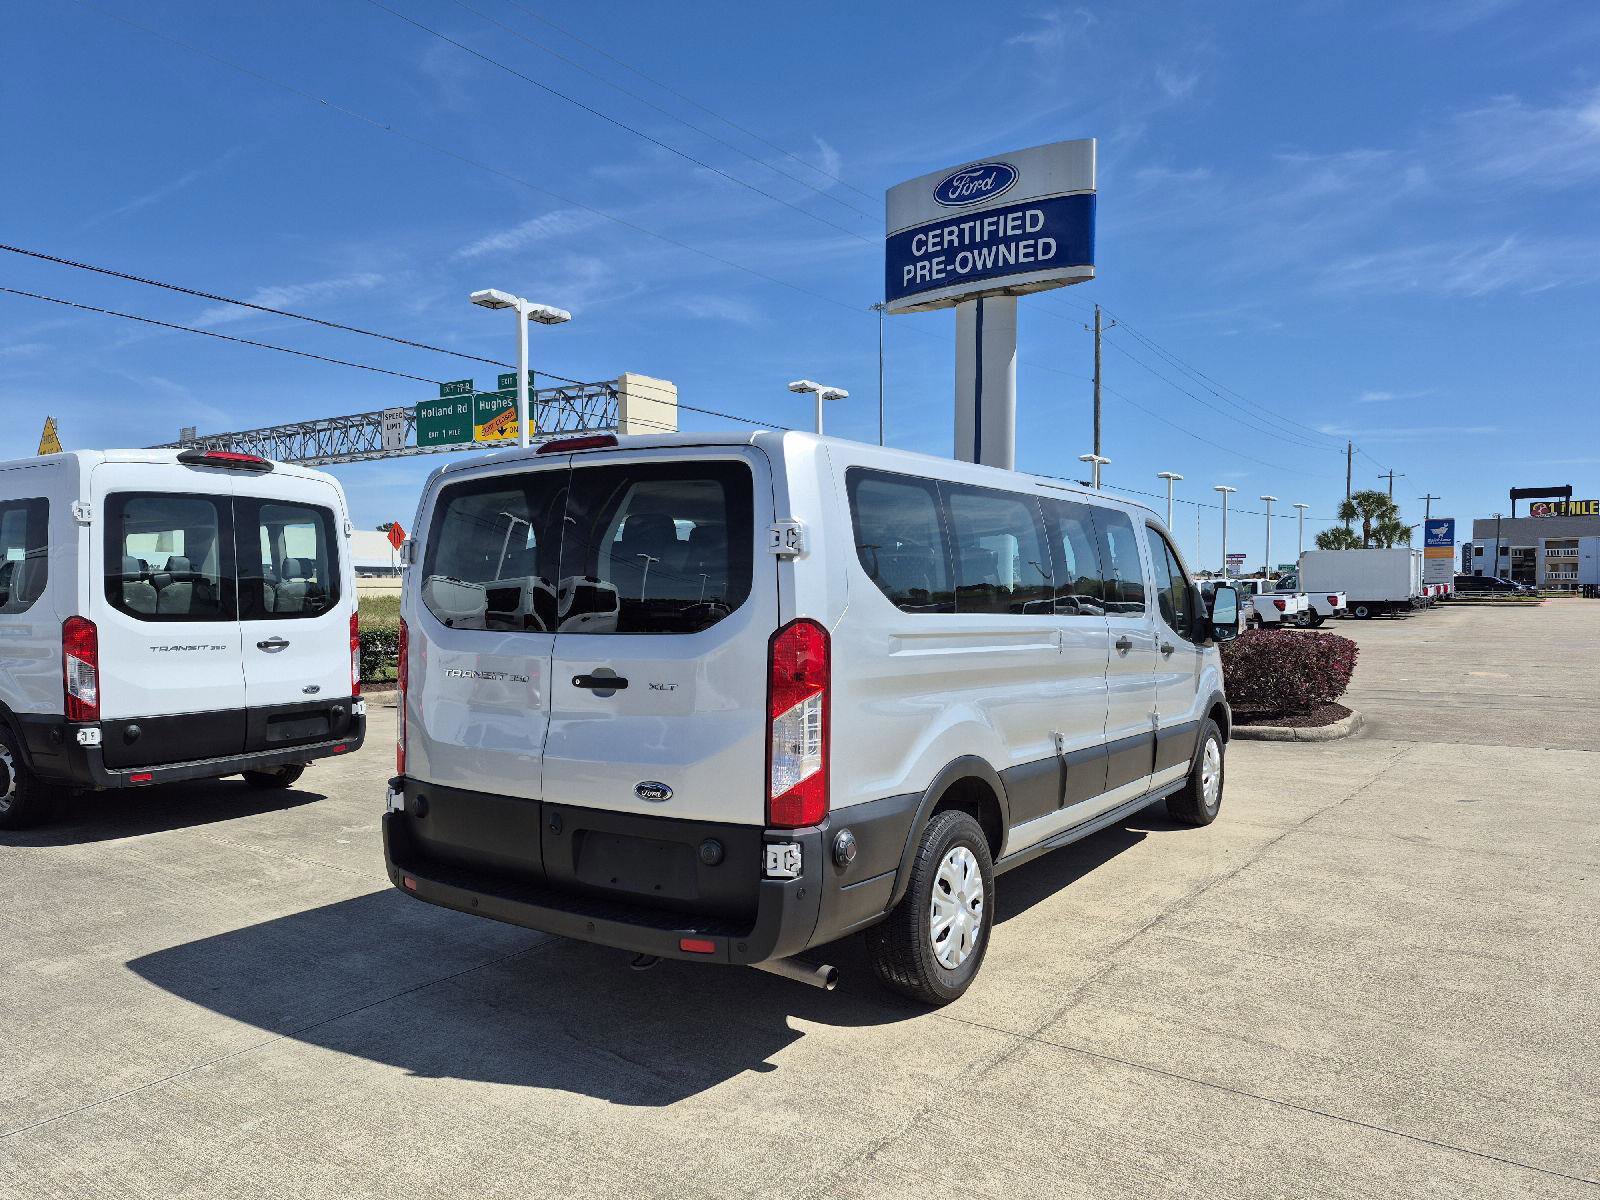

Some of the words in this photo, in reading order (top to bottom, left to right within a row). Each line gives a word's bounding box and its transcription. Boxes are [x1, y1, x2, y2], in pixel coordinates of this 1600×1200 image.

[948, 169, 996, 199] Ford
[911, 209, 1045, 257] CERTIFIED
[903, 237, 1057, 287] PRE-OWNED
[501, 377, 513, 386] EXIT
[479, 397, 513, 411] Hughes
[384, 412, 403, 421] SPEED
[421, 404, 453, 419] Holland
[457, 403, 468, 414] Rd
[386, 422, 401, 431] LIMIT
[442, 429, 446, 439] 1
[448, 428, 461, 437] MILE
[150, 644, 209, 652] TRANSIT
[445, 668, 508, 681] TRANSIT
[648, 682, 679, 691] XLT
